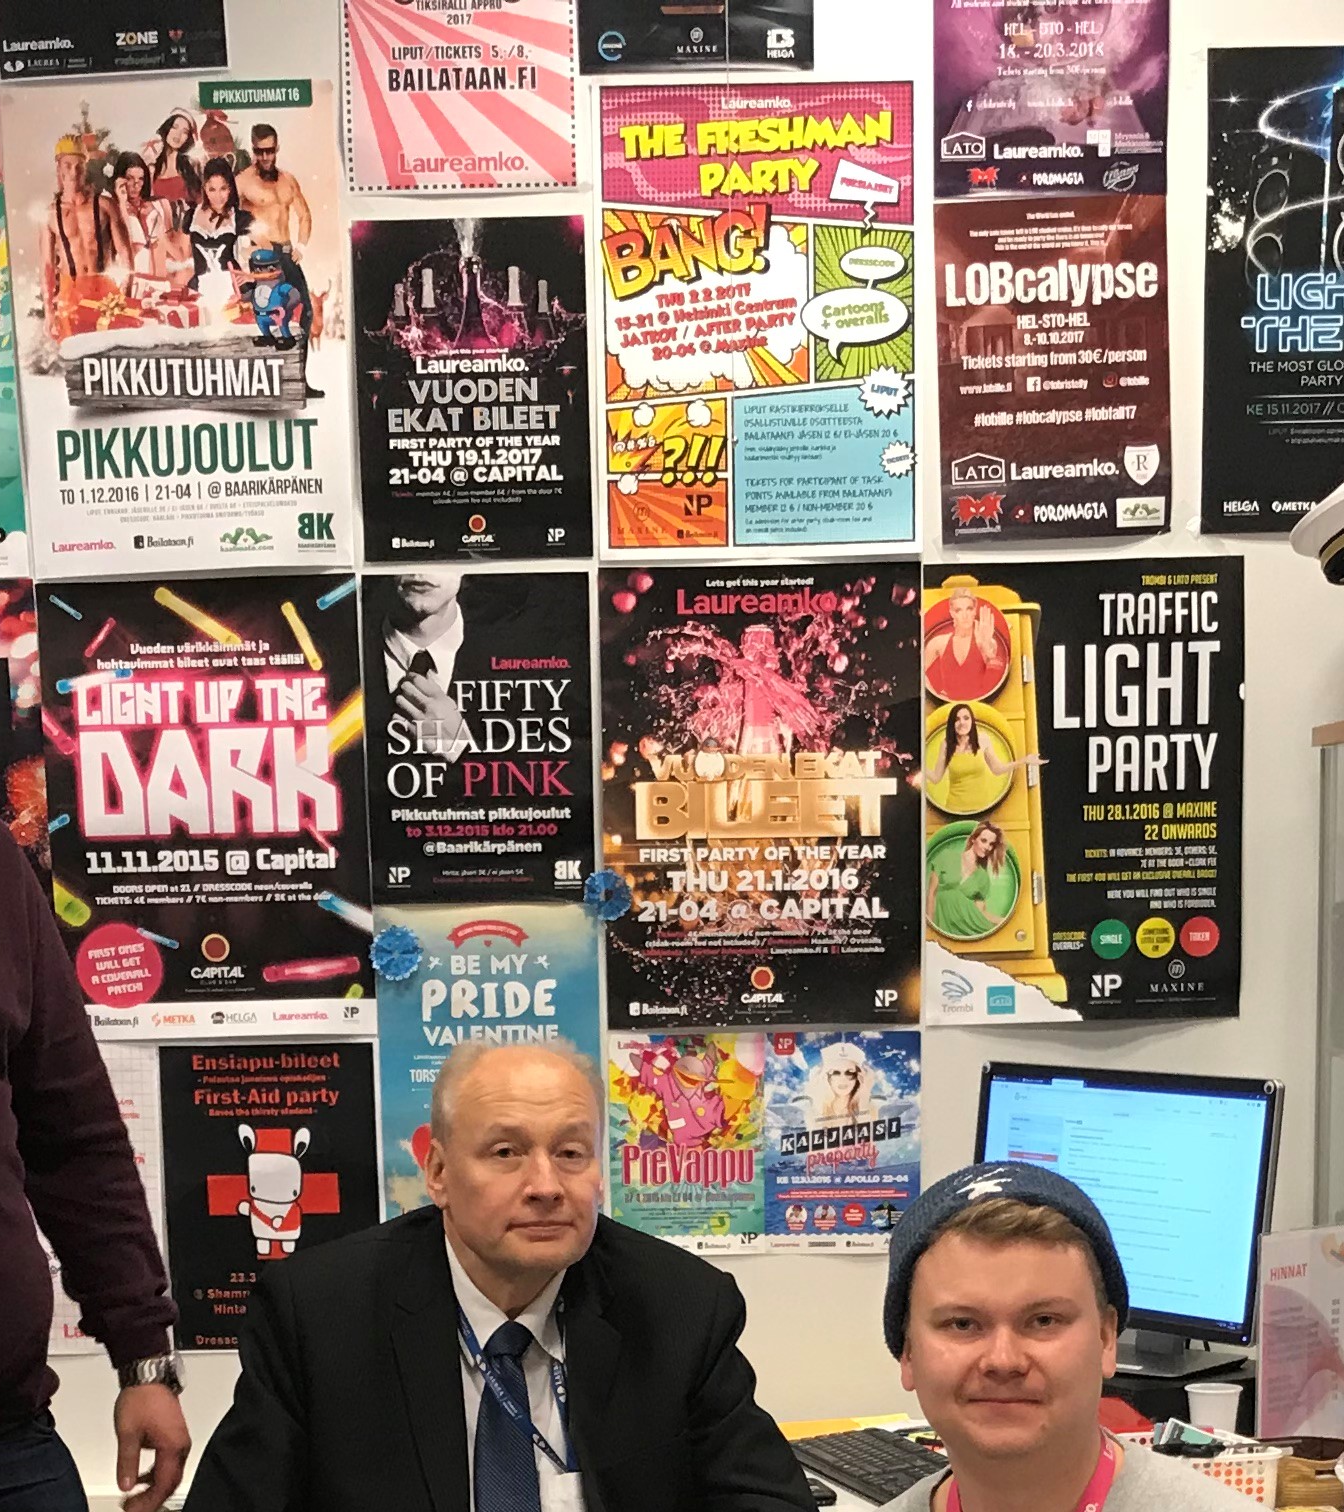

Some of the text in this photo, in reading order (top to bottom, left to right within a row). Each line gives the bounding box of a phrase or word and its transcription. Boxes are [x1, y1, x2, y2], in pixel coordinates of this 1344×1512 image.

[446, 13, 472, 26] 2017
[3, 37, 74, 52] Laureamko.
[115, 30, 158, 46] ZONE
[388, 66, 537, 92] BAILATAAN.FI
[619, 111, 892, 159] THE FRESHMAN
[399, 151, 529, 173] Laureamko.
[994, 143, 1084, 160] Laureamko.
[699, 157, 821, 197] PARTY
[600, 202, 772, 301] BANG!
[945, 258, 1158, 307] LOBcalypse
[822, 301, 885, 318] Cartoons
[833, 313, 890, 329] overalls
[1016, 312, 1090, 329] HEL-STO-HEL
[1238, 315, 1344, 353] THE
[416, 354, 529, 375] Laureamko.
[961, 352, 1077, 370] Tickets from
[1249, 360, 1274, 373] THE
[1277, 359, 1314, 372] MOST
[83, 358, 284, 396] PIKKUTUHMAT
[1301, 374, 1343, 387] PARTY
[408, 377, 538, 404] VUODEN
[388, 404, 560, 433] EKAT BILEET
[1016, 405, 1137, 425] #lobcalypse #lobfall17
[56, 418, 318, 481] PIKKUJOULUT
[389, 435, 560, 450] FIRST PARTY OF THE YEAR
[409, 449, 542, 467] THU 19.1.2017
[389, 464, 564, 485] 21-04 CAPITAL
[954, 466, 1002, 480] LATO
[1010, 459, 1120, 481] Laureamko.
[60, 478, 323, 505] TO 1.12.2016 21-04 BAARIKÄRPÄNEN
[1033, 502, 1108, 523] POROMAGIA
[1224, 500, 1260, 512] HELGA
[52, 540, 117, 553] Laureamko.
[1099, 591, 1218, 635] TRAFFIC
[130, 642, 174, 655] Vuoden
[491, 656, 571, 670] Laureamko.
[1053, 641, 1220, 729] LIGHT
[77, 678, 327, 726] LIGHT UP THE
[454, 679, 572, 713] FIFTY
[387, 716, 571, 755] SHADES
[1088, 733, 1218, 793] PARTY
[79, 726, 338, 837] DARK
[387, 760, 574, 799] OF PINK
[391, 807, 571, 822] Pikkutuhmat pikkujoulut
[636, 777, 897, 840] BILEET
[1083, 801, 1218, 821] THU 28.1.2016 MAXINE
[1162, 823, 1217, 840] ONWARDS
[423, 840, 542, 856] @Baarikärpänen
[639, 845, 886, 862] FIRST PARTY OF THE YEAR
[86, 848, 337, 876] 11.11.2015 Capital
[667, 868, 860, 893] THU 21.1.2016
[638, 898, 889, 922] 21-04 CAPITAL
[191, 966, 245, 979] CAPITAL
[451, 954, 528, 975] BE MY
[1150, 983, 1204, 992] MAXINE
[421, 979, 557, 1022] PRIDE
[741, 993, 784, 1004] CAPITAL
[163, 1012, 257, 1024] METKA HELGA
[423, 1024, 559, 1047] VALENTINE
[192, 1053, 340, 1074] Ensiapu-bileet
[194, 1088, 340, 1107] First-Aid party
[782, 1121, 897, 1152] KALJAASI
[622, 1144, 755, 1189] PreVappu
[1270, 1263, 1308, 1281] HINNAT
